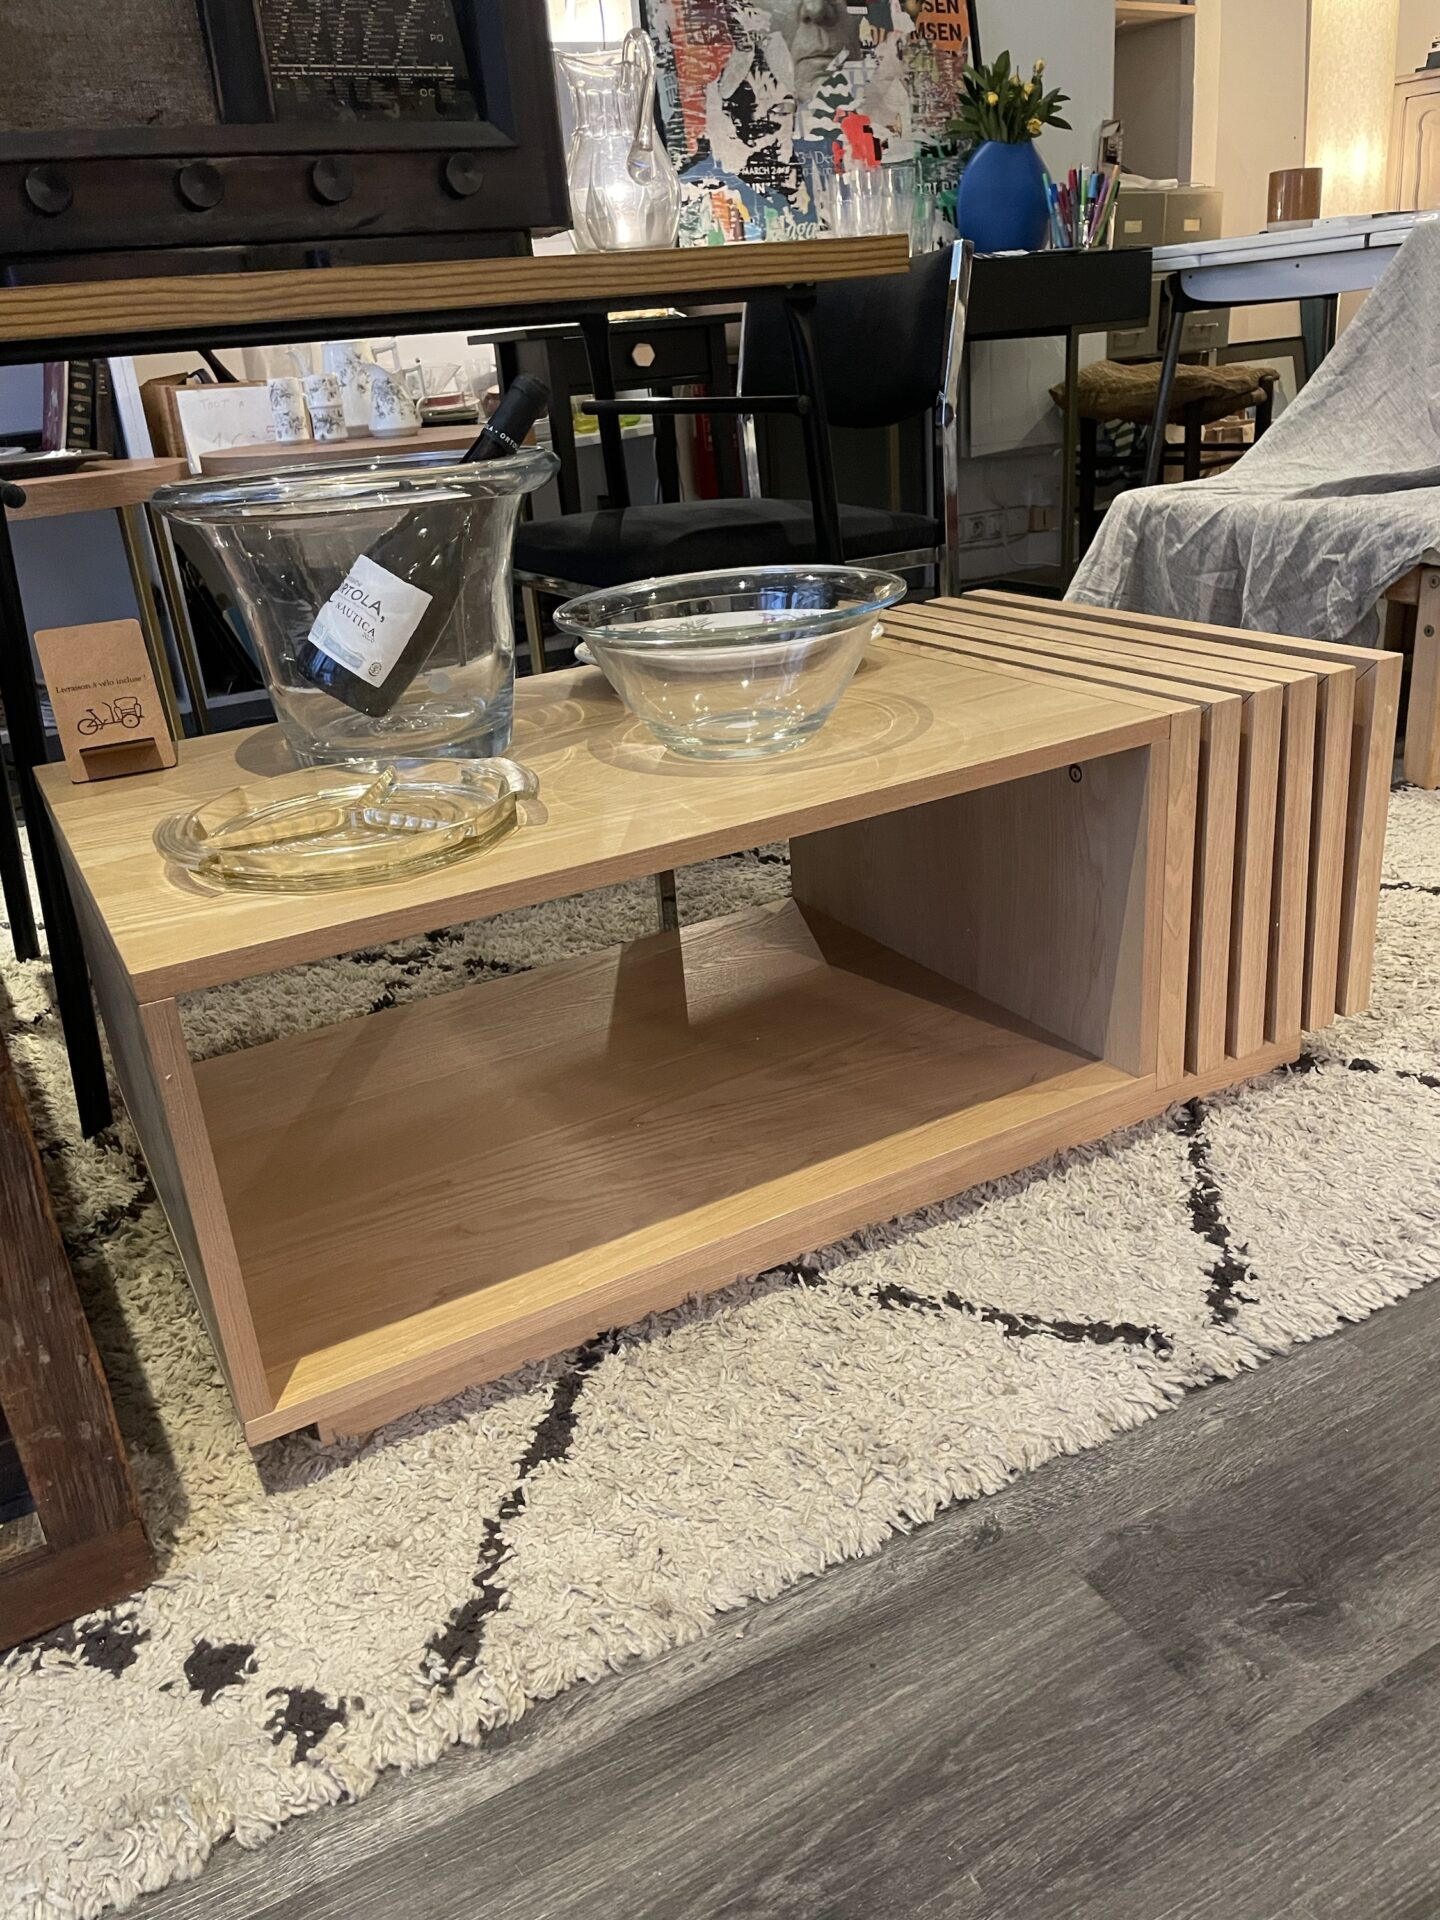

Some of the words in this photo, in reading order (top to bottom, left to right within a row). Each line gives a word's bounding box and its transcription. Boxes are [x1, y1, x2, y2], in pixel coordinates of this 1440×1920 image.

[919, 0, 960, 14] SEN
[419, 88, 436, 97] OC
[499, 432, 520, 451] ORTO
[55, 683, 91, 694] Livraison
